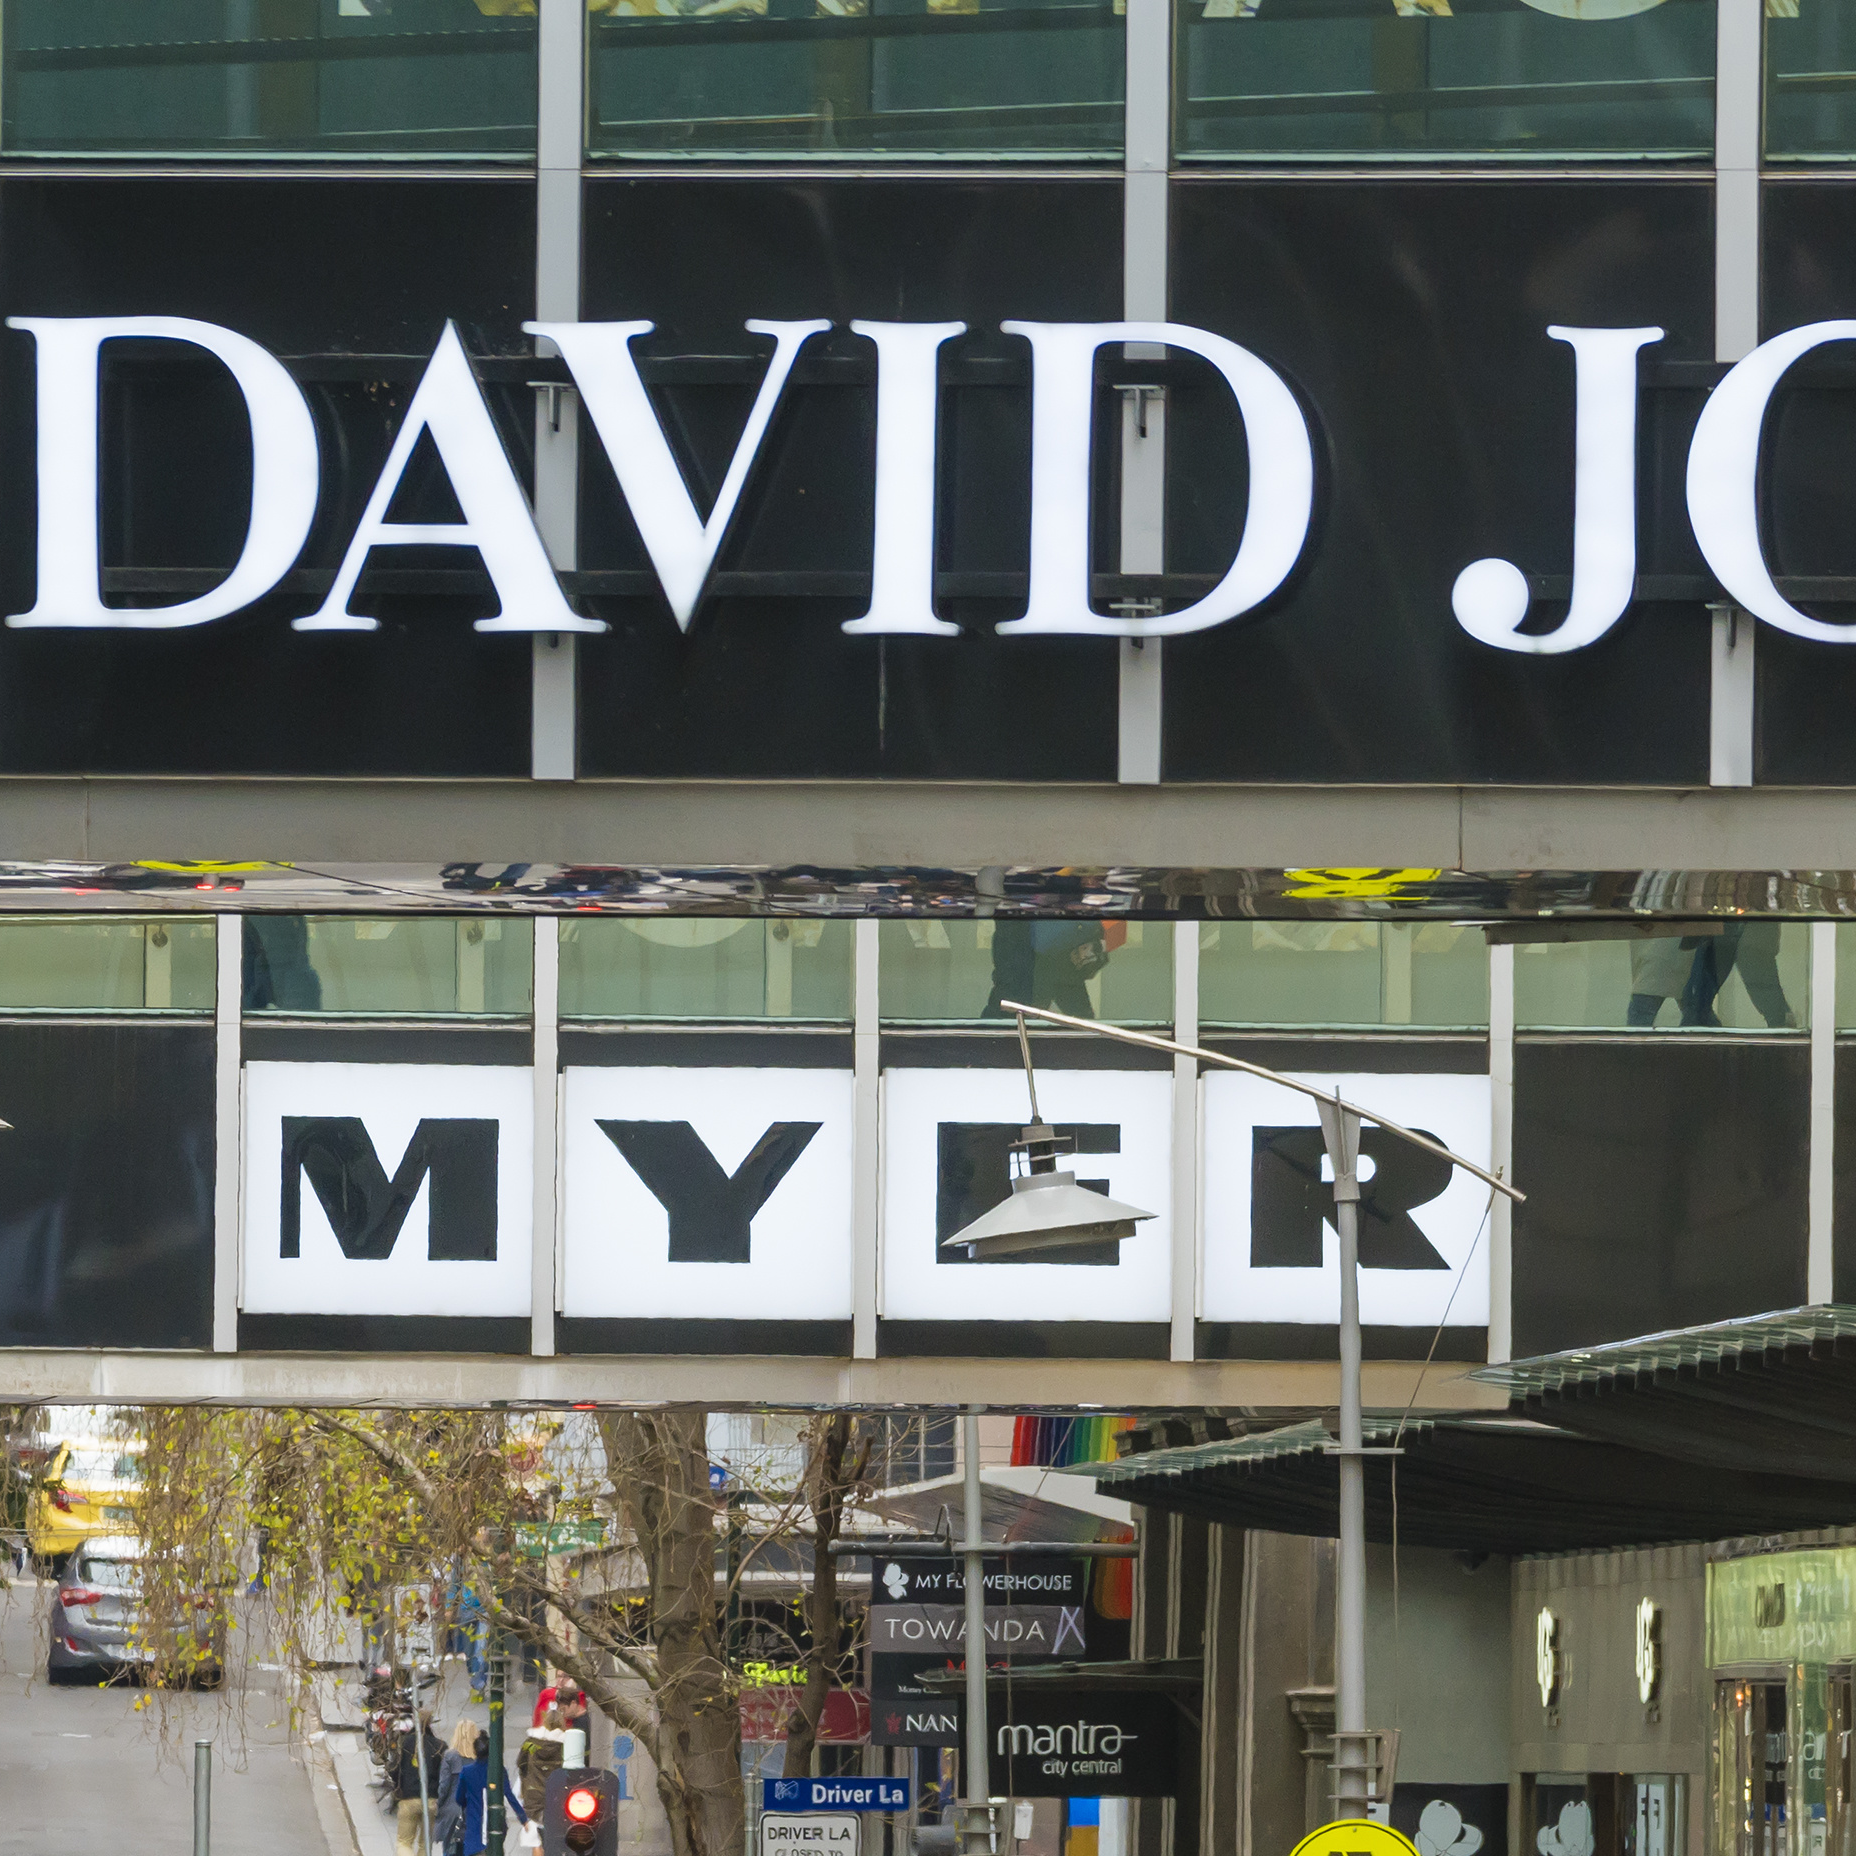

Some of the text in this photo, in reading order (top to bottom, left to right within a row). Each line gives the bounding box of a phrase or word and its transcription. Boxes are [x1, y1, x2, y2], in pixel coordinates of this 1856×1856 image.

[3, 313, 1317, 640] DAVID
[279, 1115, 1453, 1272] MYER
[915, 1573, 1073, 1591] MY FLWERHOUSE
[997, 1719, 1139, 1756] mantra
[1042, 1757, 1122, 1778] city central
[811, 1783, 905, 1805] Driver La
[767, 1826, 852, 1841] DRIVER LA
